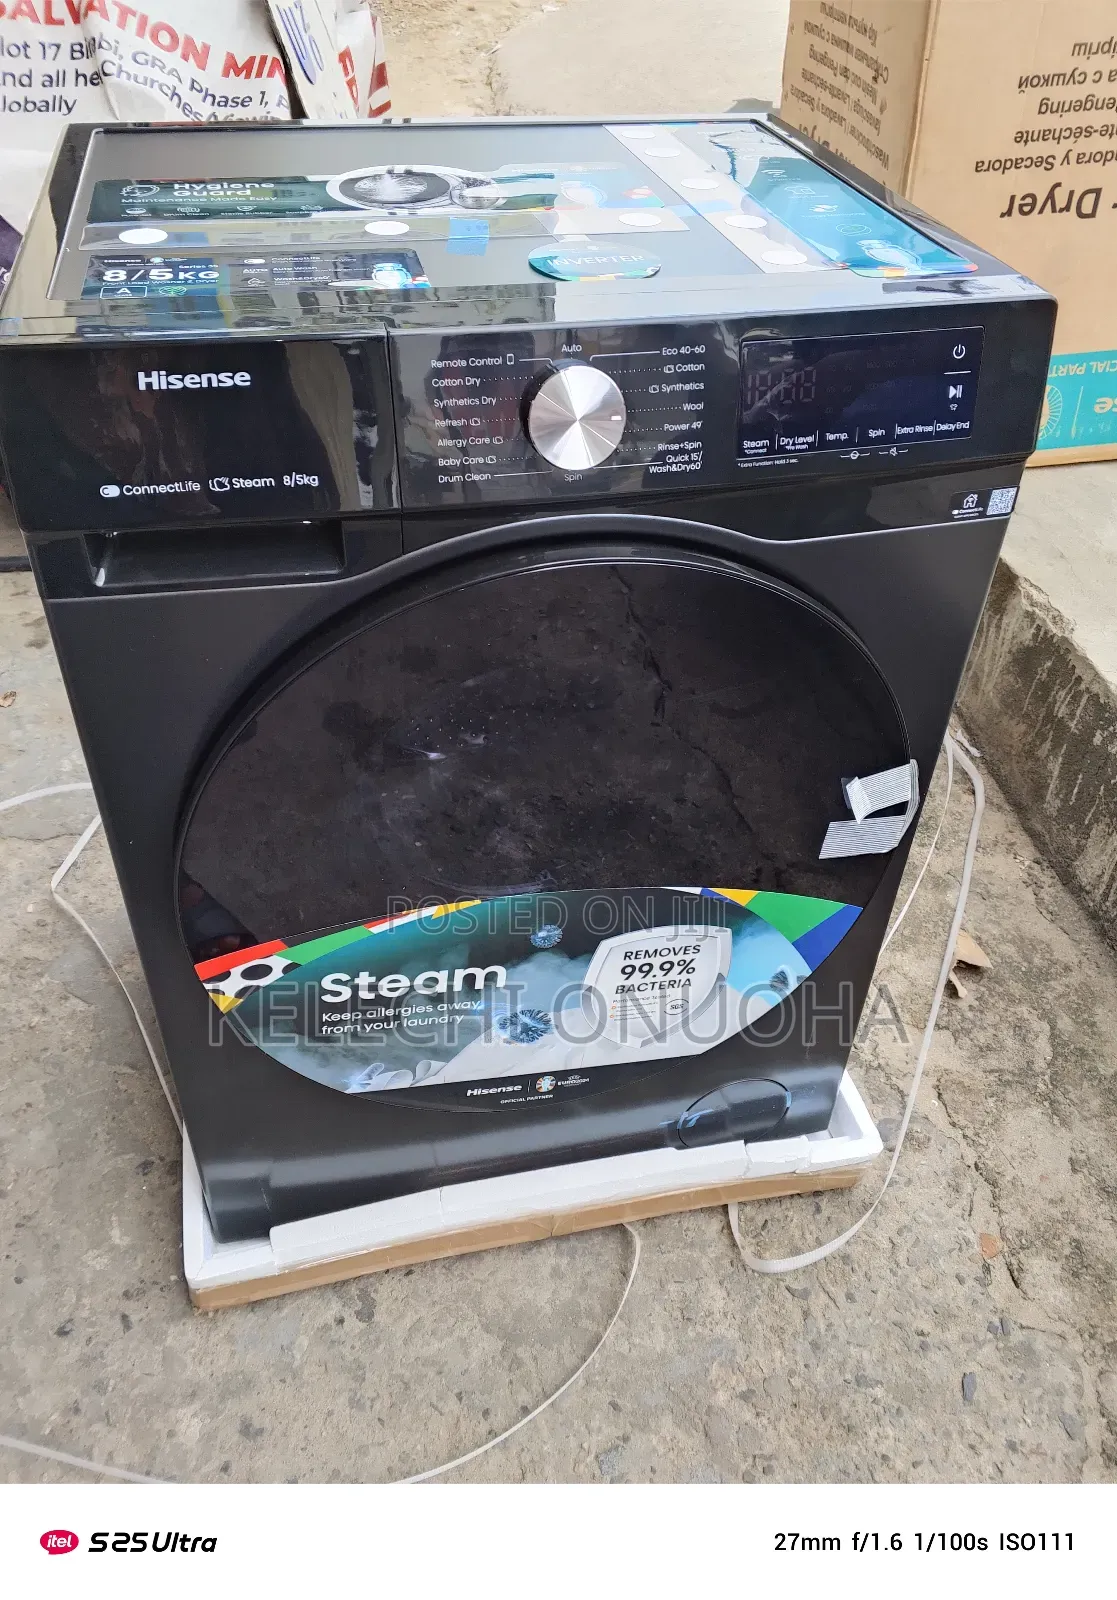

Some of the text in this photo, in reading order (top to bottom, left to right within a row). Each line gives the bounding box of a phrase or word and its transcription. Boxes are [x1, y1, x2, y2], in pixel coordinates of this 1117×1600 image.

[39, 41, 62, 60] 17
[132, 51, 182, 84] GRA
[189, 77, 252, 108] Phase
[259, 90, 269, 108] 1,
[41, 69, 66, 87] all
[1018, 67, 1088, 94] сушкой
[1, 94, 77, 116] lobally
[1038, 94, 1117, 118] engering
[1060, 149, 1073, 168] y
[974, 155, 1057, 175] Secadora
[173, 189, 251, 197] Guard
[999, 182, 1103, 219] Dryer
[547, 254, 645, 266] INVERTER
[561, 344, 582, 353] Auto
[662, 345, 706, 356] Eco 40-60
[431, 356, 503, 368] Remote Control
[675, 363, 705, 373] Cotton
[137, 370, 251, 391] Hisense
[432, 376, 481, 388] Cotton Dry
[661, 382, 705, 393] Synthetics
[434, 396, 497, 408] Synthetics Dry
[682, 402, 704, 411] Wool
[435, 418, 468, 428] Refresh
[664, 423, 690, 432] Power
[936, 420, 970, 432] Delay End
[868, 428, 886, 438] Spin
[897, 424, 934, 435] Extra Rinse
[437, 436, 491, 448] Allergy Care
[780, 434, 815, 446] Dry Level
[826, 432, 849, 442] Temp.
[657, 441, 702, 451] Rinse+Spin
[743, 440, 770, 449] Steam
[438, 456, 485, 468] Baby Care
[666, 453, 689, 465] Quick
[438, 472, 492, 484] Drum Clean
[564, 473, 583, 482] Spin
[123, 472, 319, 496] ConnectLife Steam 8/5kg
[623, 944, 701, 961] REMOVES
[620, 958, 696, 982] 99.9%
[320, 964, 507, 1003] Steam
[614, 977, 692, 995] BACTERIA
[322, 1000, 481, 1023] Keep allergies away
[322, 1013, 464, 1035] from your laundry
[466, 1085, 523, 1097] Hisense
[526, 1094, 554, 1102] PARTNER
